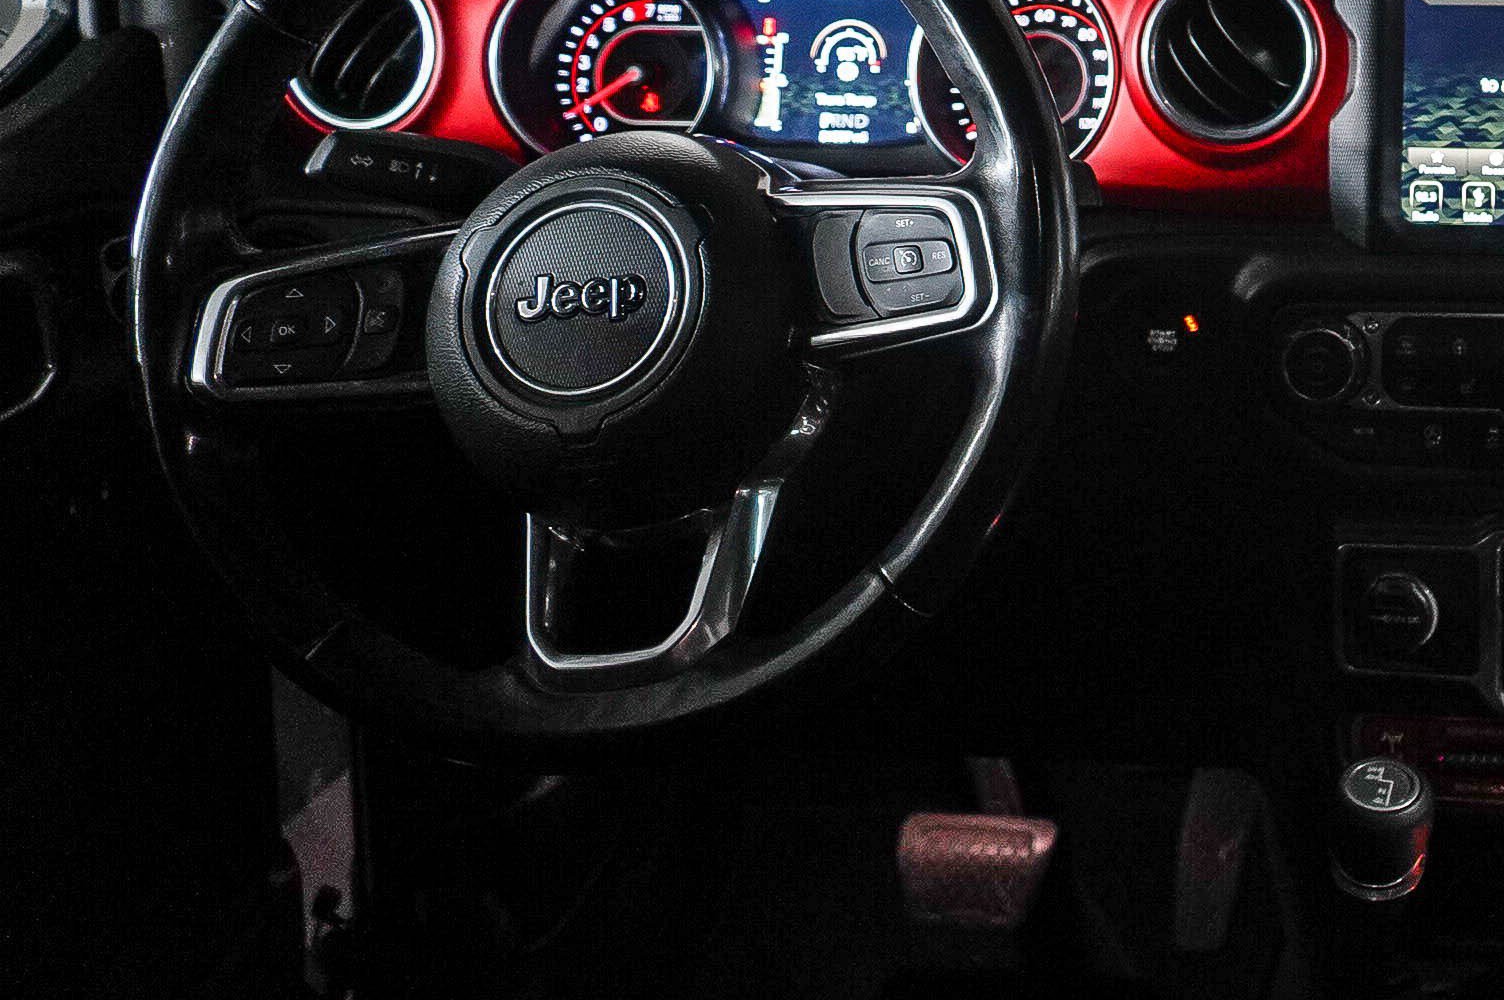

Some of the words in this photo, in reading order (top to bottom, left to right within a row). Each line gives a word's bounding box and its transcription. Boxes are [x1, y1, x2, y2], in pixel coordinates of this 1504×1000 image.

[622, 6, 636, 22] 6
[643, 2, 656, 18] 7
[577, 53, 592, 71] 3
[576, 76, 590, 93] 2
[1480, 77, 1500, 93] to
[593, 116, 608, 132] 0
[868, 257, 891, 267] CANC
[931, 251, 946, 261] RES
[515, 272, 648, 325] Jeep
[278, 325, 296, 336] OK
